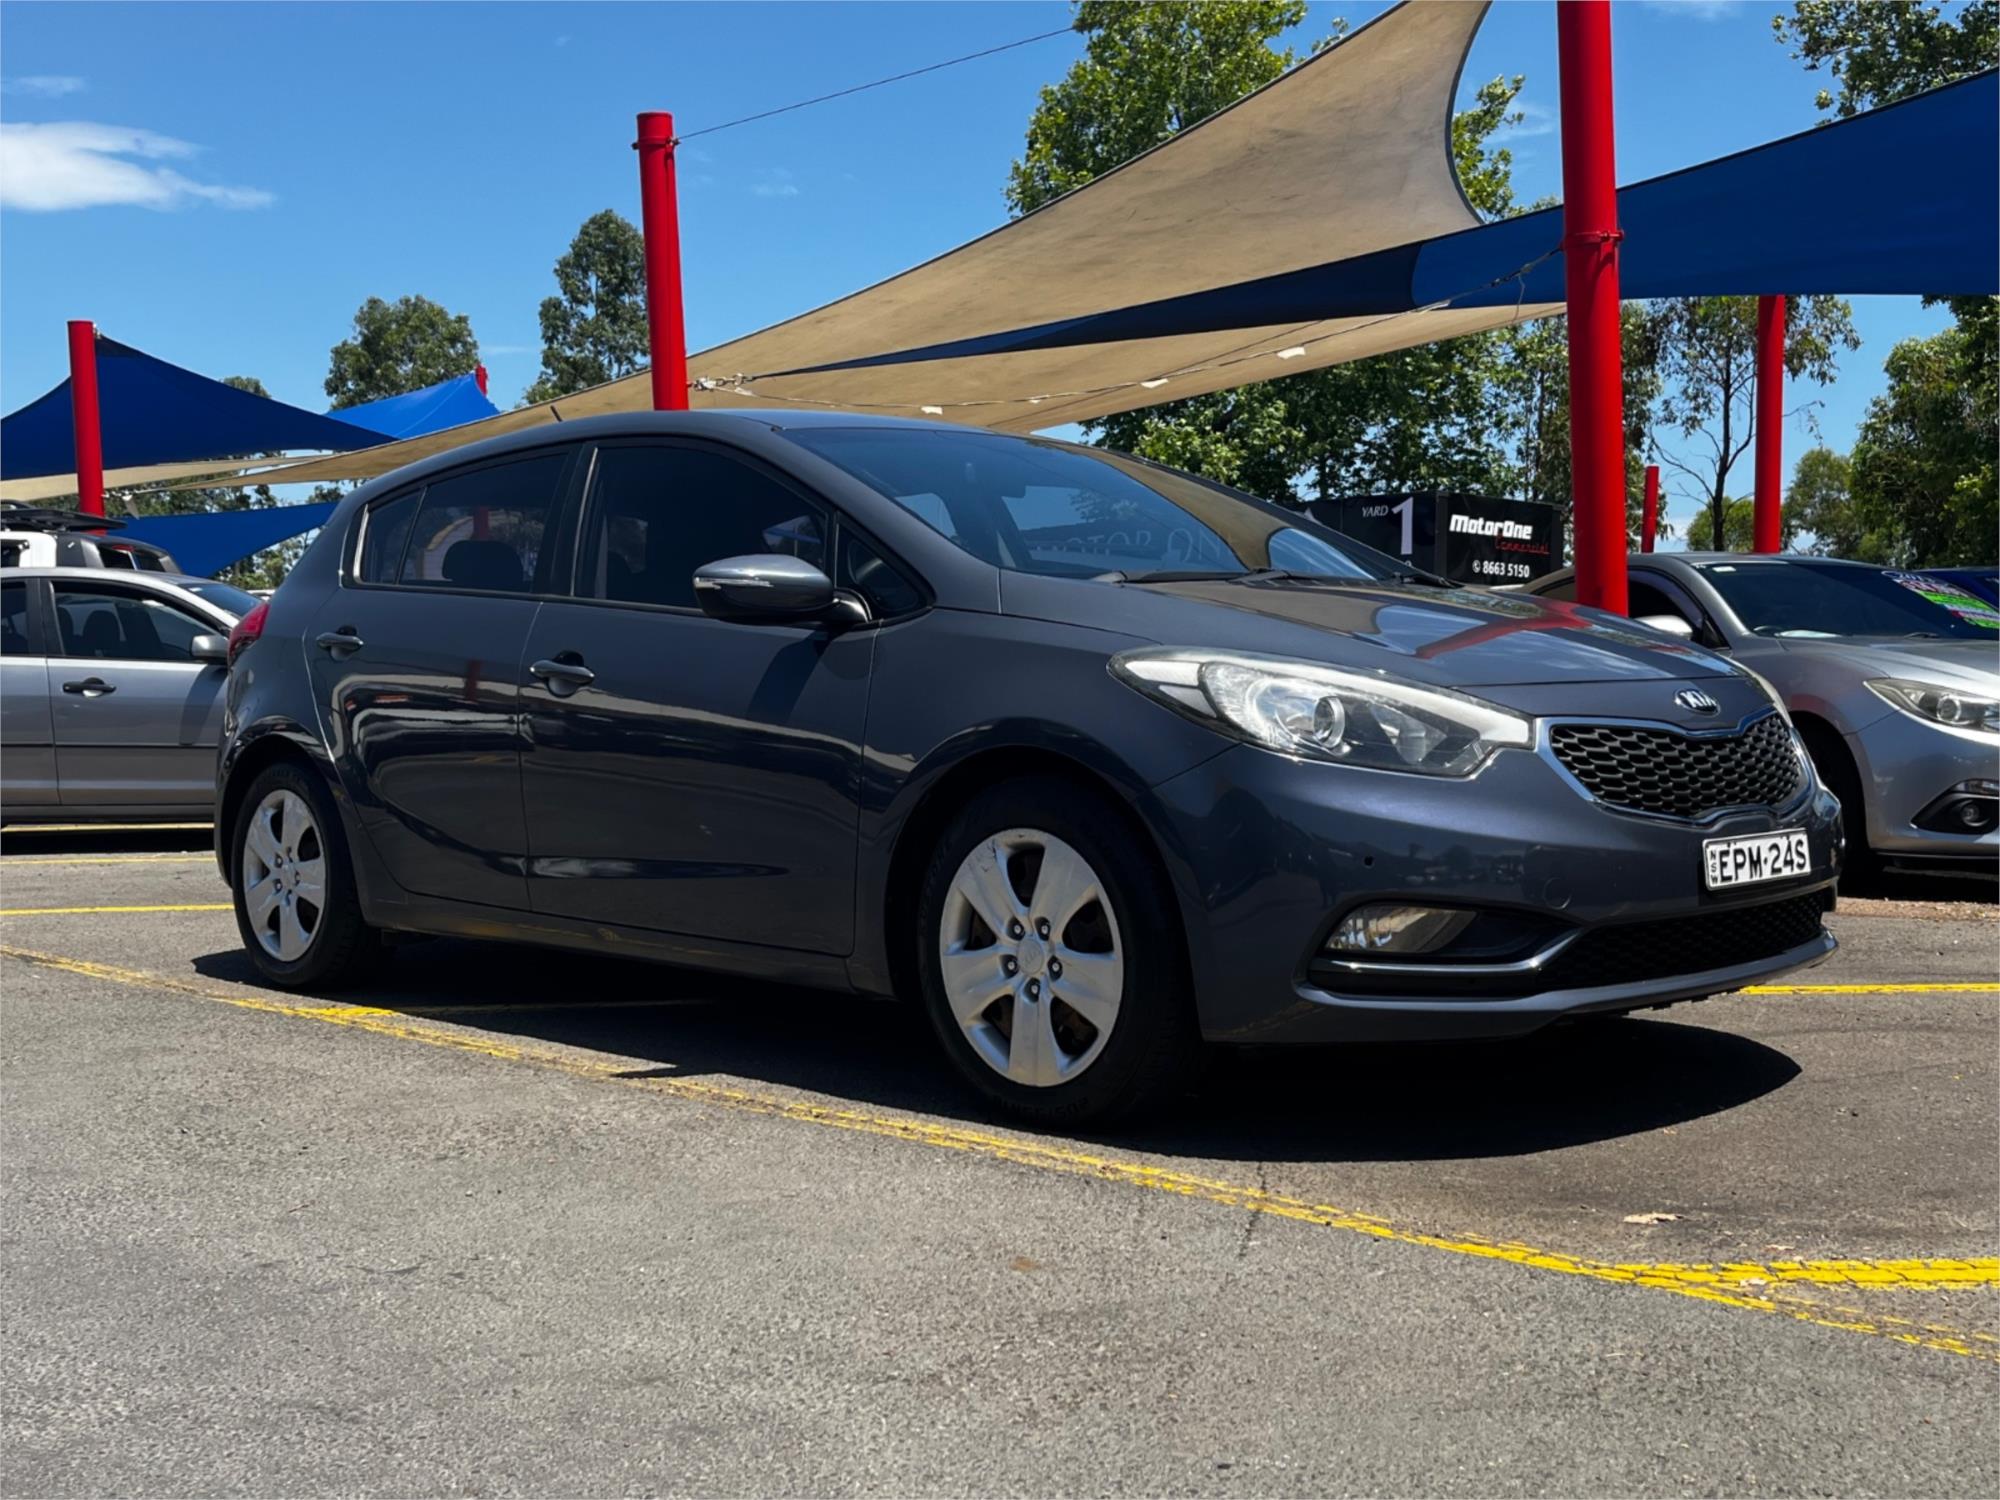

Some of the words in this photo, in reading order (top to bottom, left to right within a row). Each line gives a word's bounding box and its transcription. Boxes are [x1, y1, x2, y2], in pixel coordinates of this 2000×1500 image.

[1362, 506, 1388, 517] YARD
[1391, 497, 1413, 555] 1
[1449, 513, 1533, 540] MotorOne
[1482, 560, 1505, 576] 8663
[1507, 562, 1530, 578] 5150
[1679, 691, 1717, 709] KIA
[1710, 851, 1719, 885] NSW
